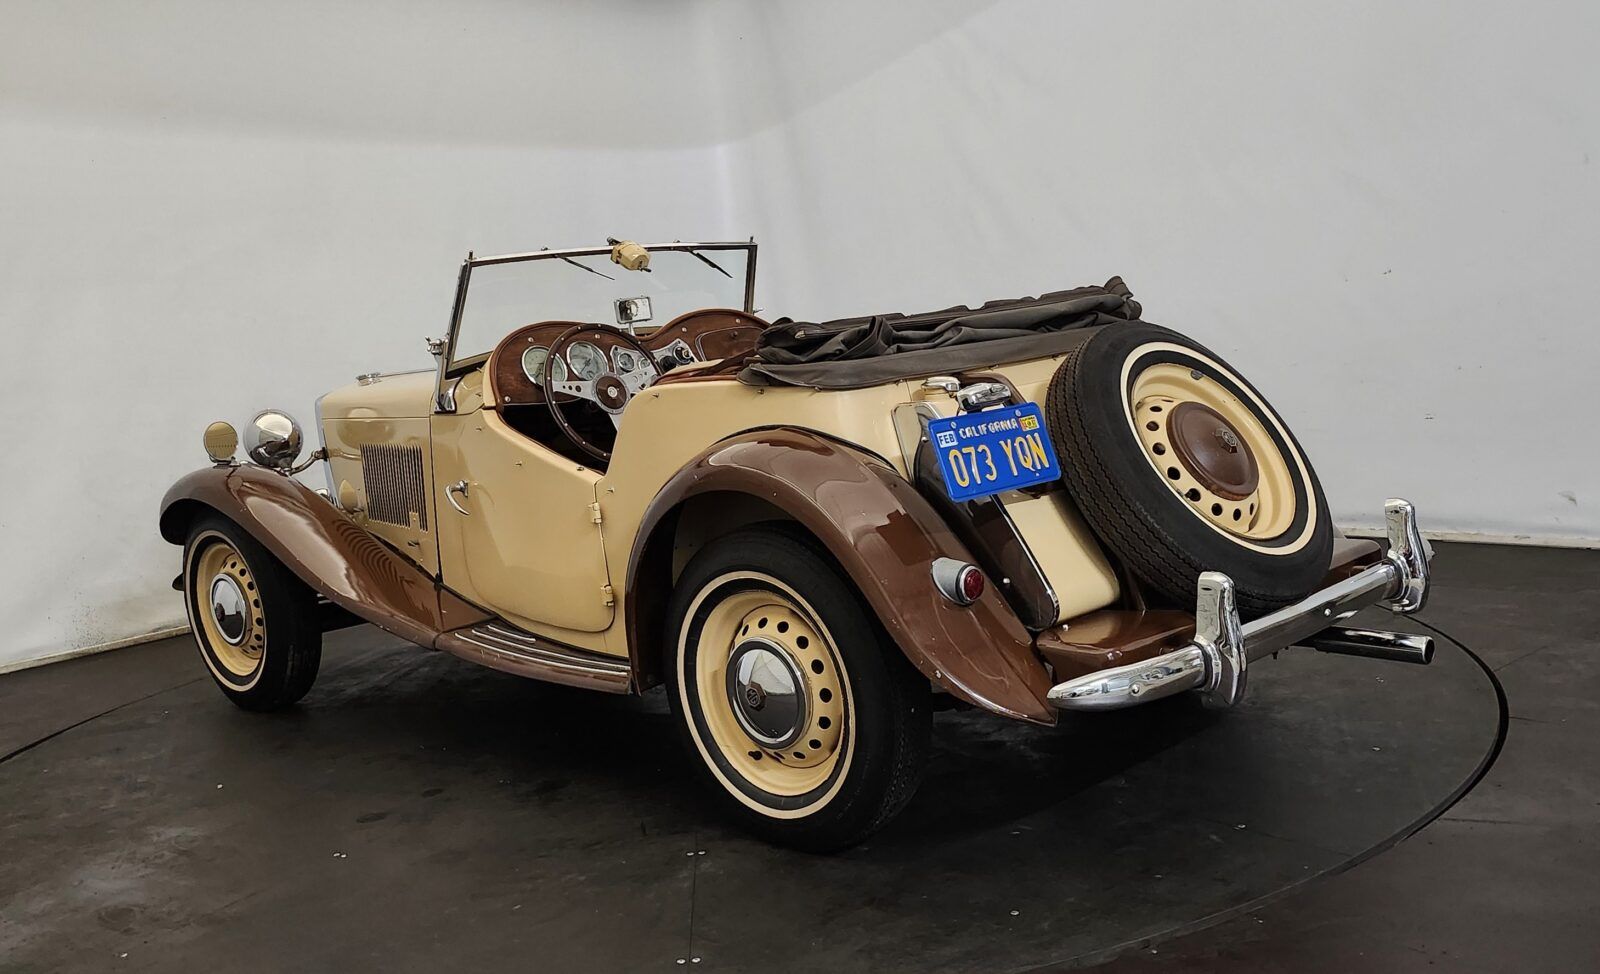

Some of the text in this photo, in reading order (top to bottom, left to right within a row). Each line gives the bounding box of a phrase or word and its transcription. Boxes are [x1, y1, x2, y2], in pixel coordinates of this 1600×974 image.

[959, 418, 1018, 439] CALIFORNIA
[938, 433, 955, 446] FEB
[948, 433, 1049, 487] 073 YQN
